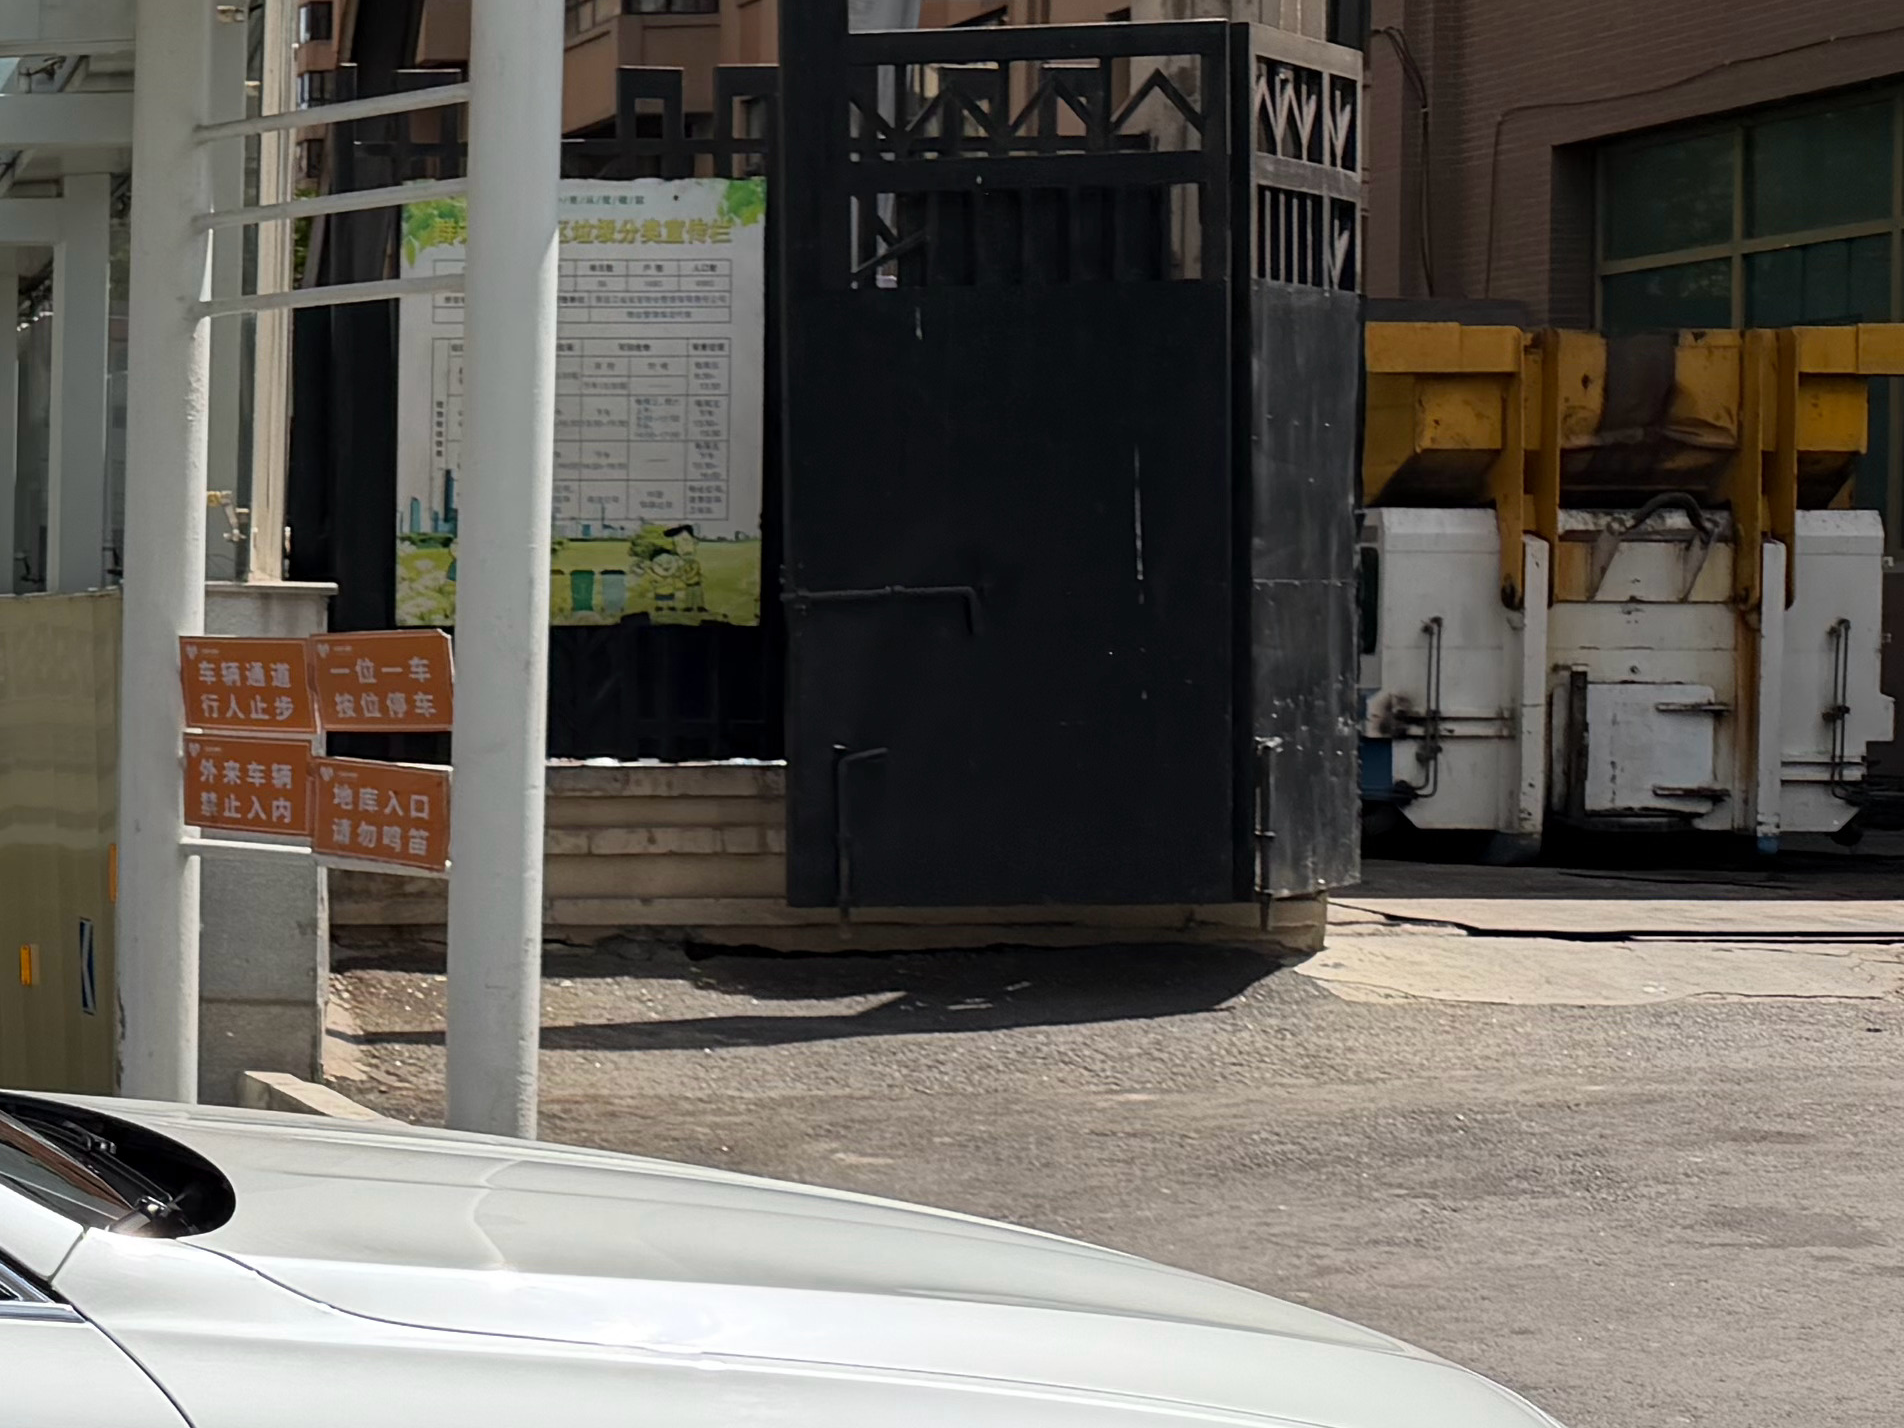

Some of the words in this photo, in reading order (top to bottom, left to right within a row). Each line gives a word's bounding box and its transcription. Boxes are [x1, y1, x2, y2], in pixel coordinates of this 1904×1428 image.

[198, 660, 292, 688] 车辆通道
[329, 656, 432, 684] 一位一车
[200, 693, 295, 721] 行人止步
[333, 691, 437, 719] 按位停车
[198, 759, 293, 790] 外来车辆
[200, 791, 293, 824] 禁止入内
[331, 783, 430, 820] 地库入口
[331, 818, 430, 856] 请勿鸣笛
